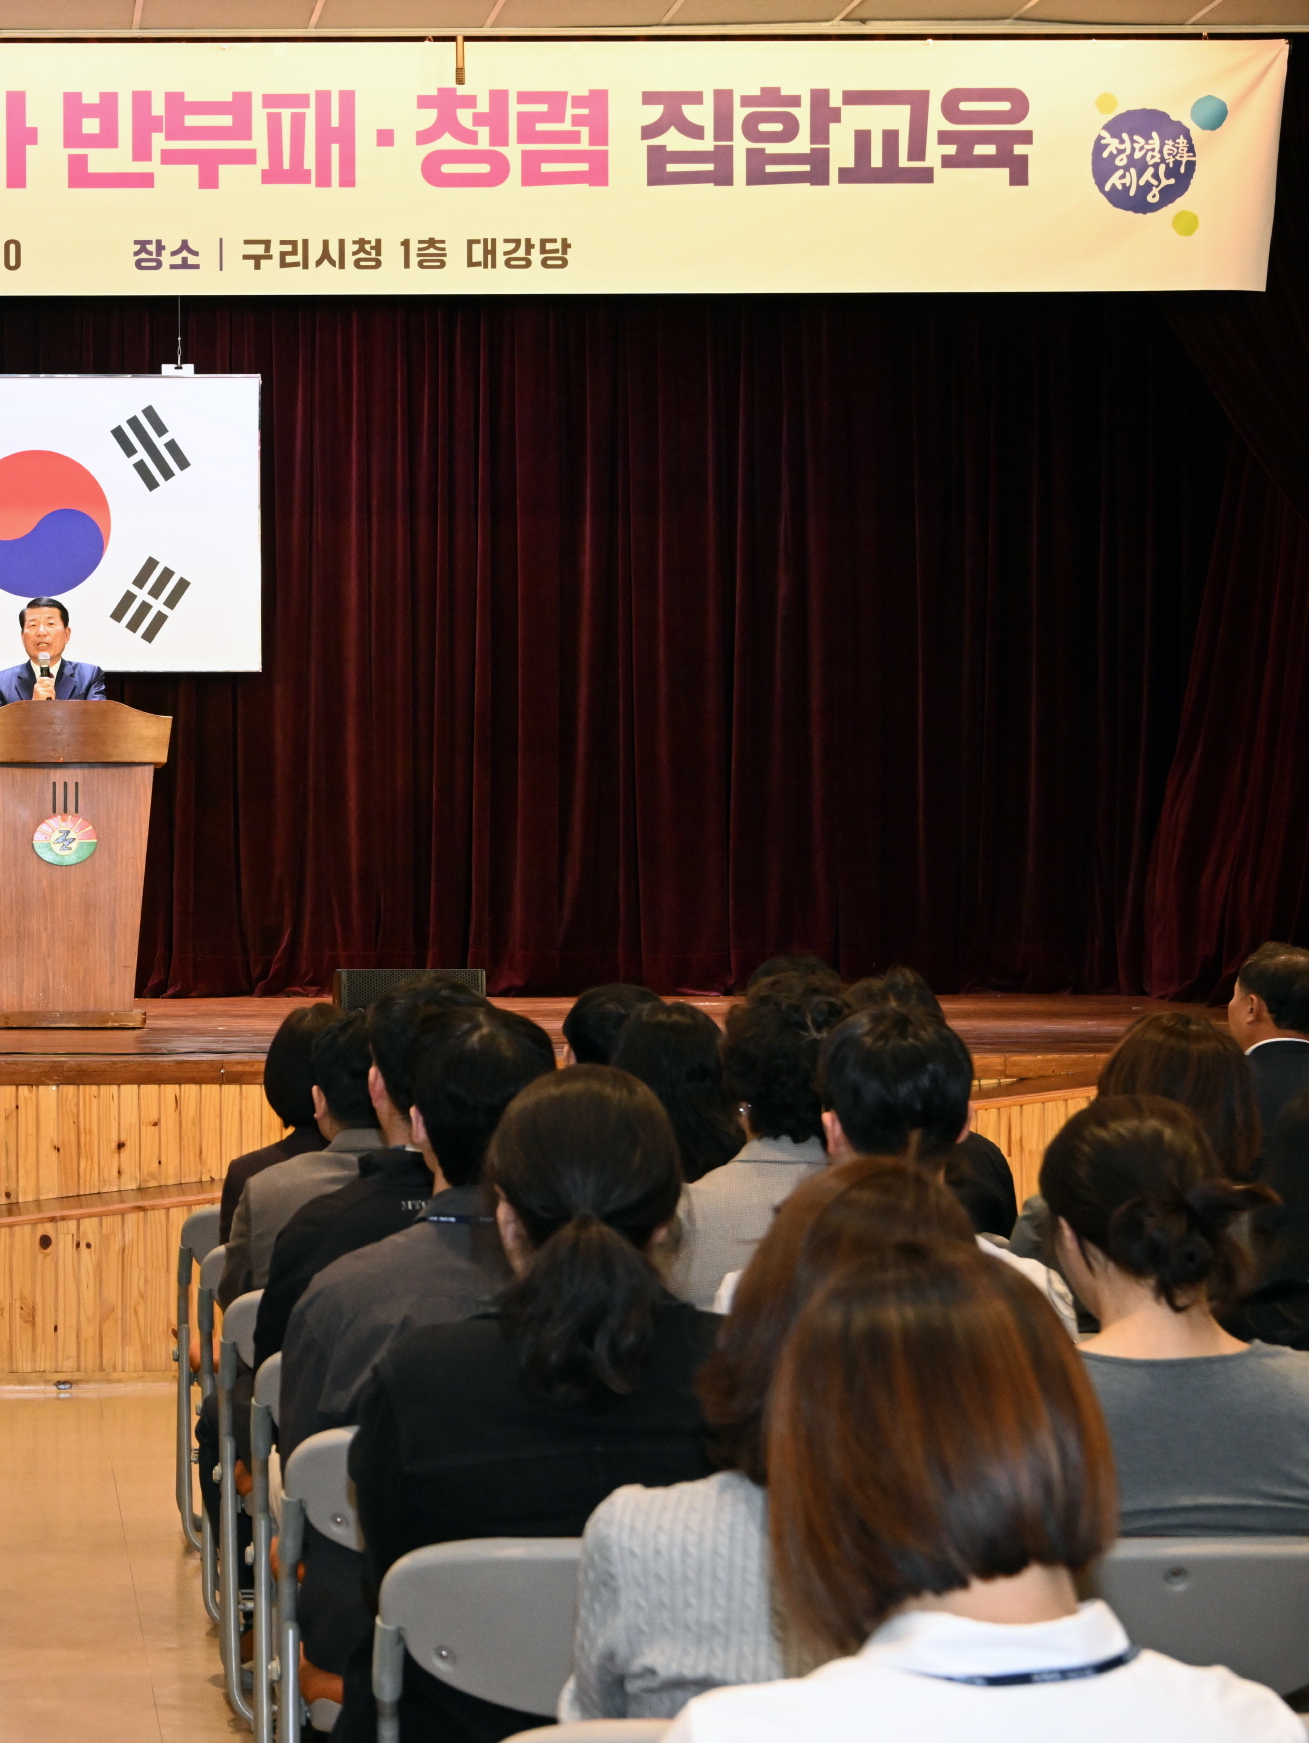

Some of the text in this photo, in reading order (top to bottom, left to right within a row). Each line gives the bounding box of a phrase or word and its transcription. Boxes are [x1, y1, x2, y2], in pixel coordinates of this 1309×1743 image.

[640, 86, 1034, 187] 집합교육
[1104, 164, 1176, 203] 세상
[133, 237, 572, 271] 장소 구리시청 1층 대강당
